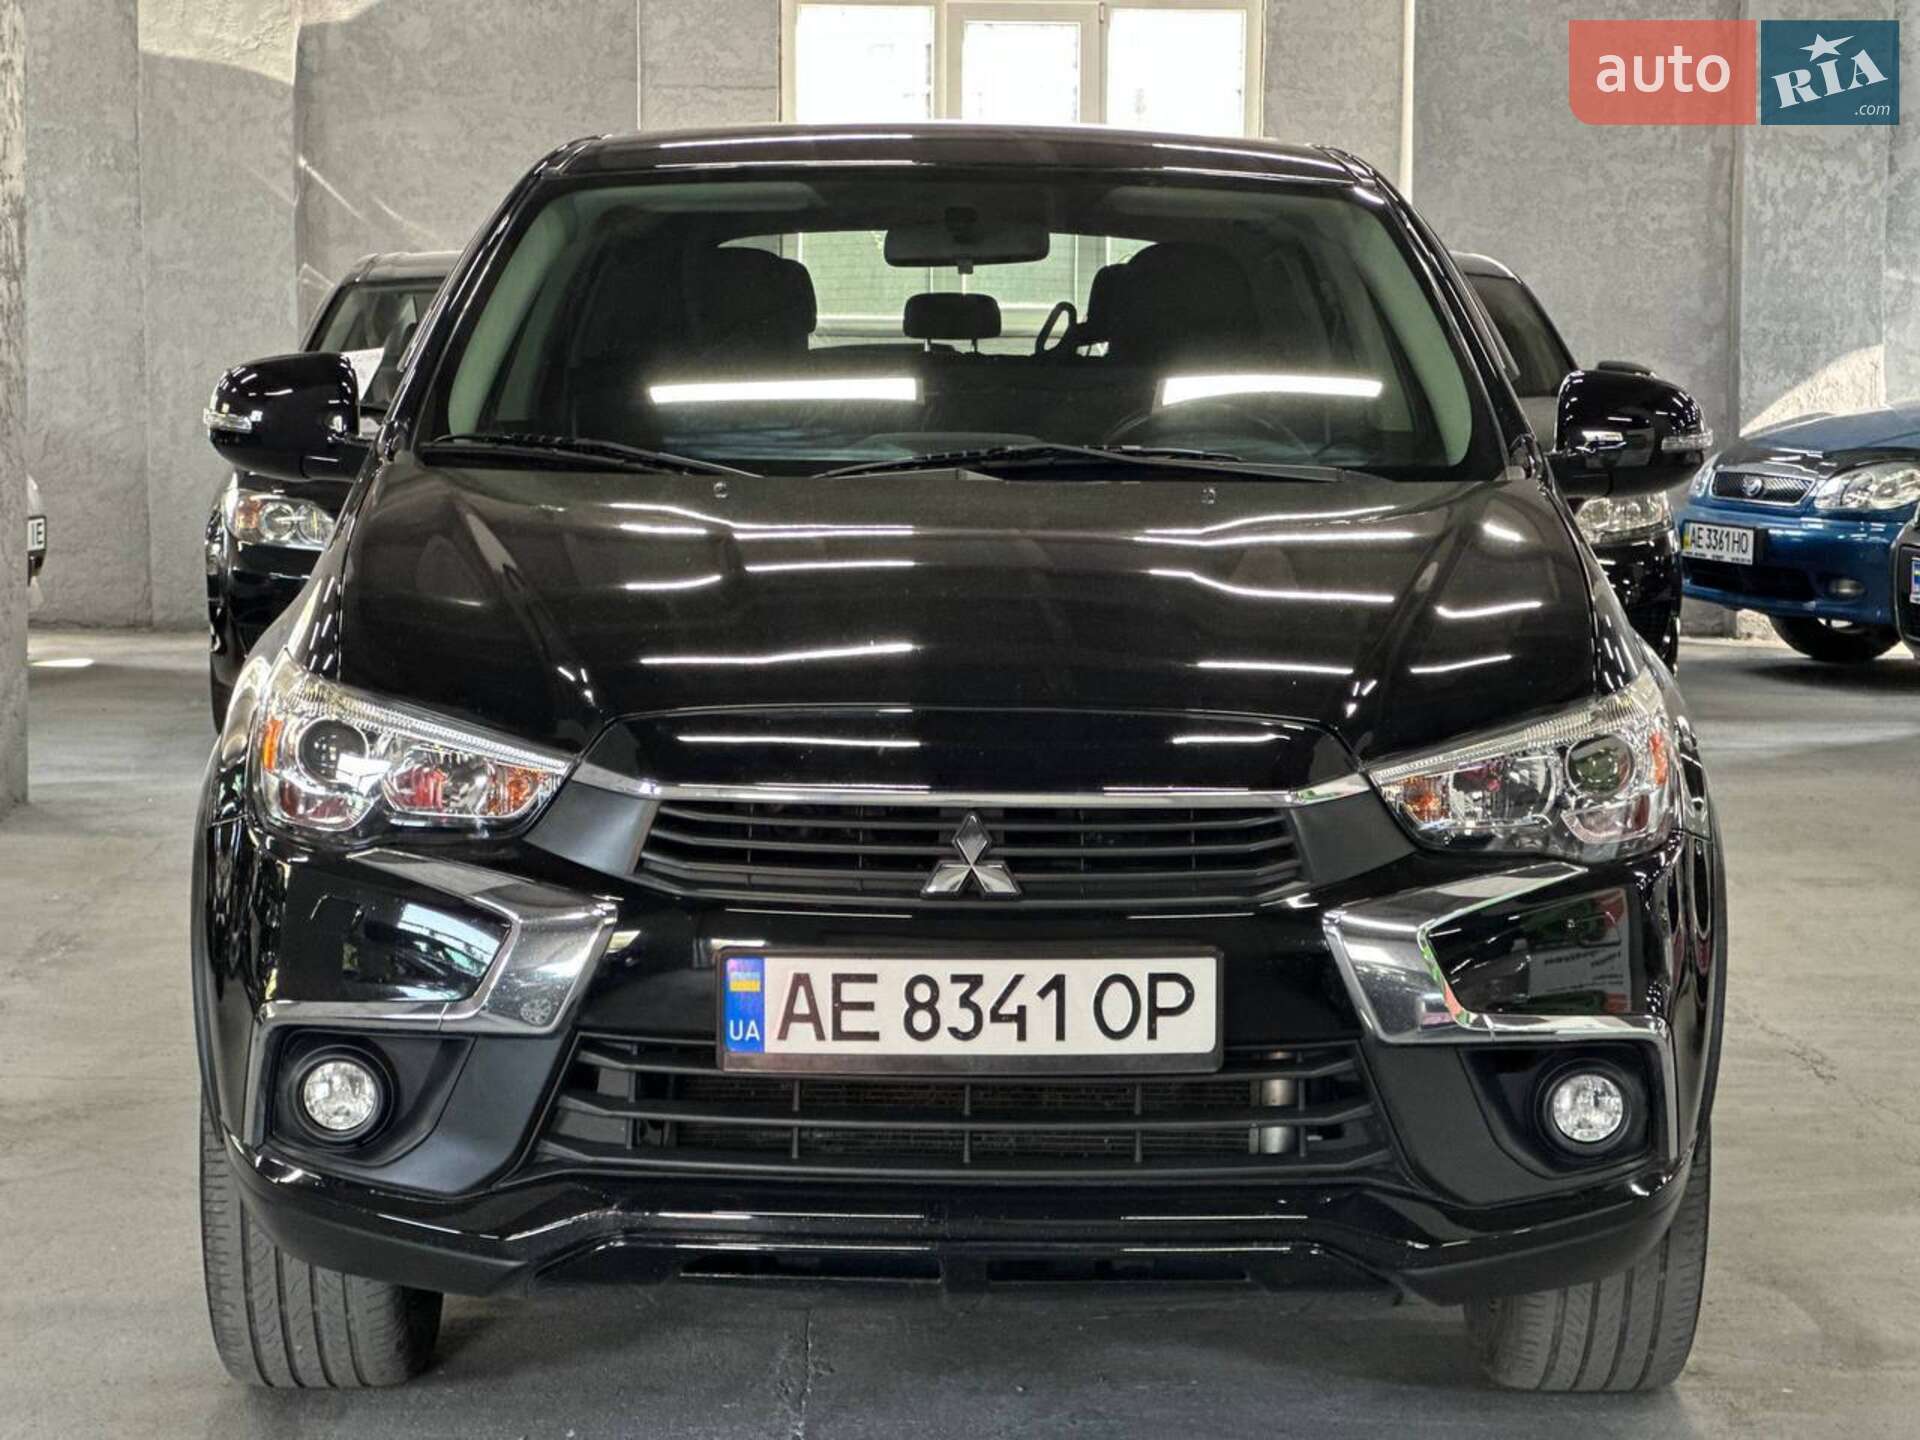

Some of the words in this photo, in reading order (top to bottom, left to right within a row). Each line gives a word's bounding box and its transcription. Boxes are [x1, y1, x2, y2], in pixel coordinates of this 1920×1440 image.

[777, 972, 880, 1041] AE
[903, 973, 1066, 1042] 8341
[1093, 972, 1195, 1041] OP
[729, 1021, 760, 1041] UA
